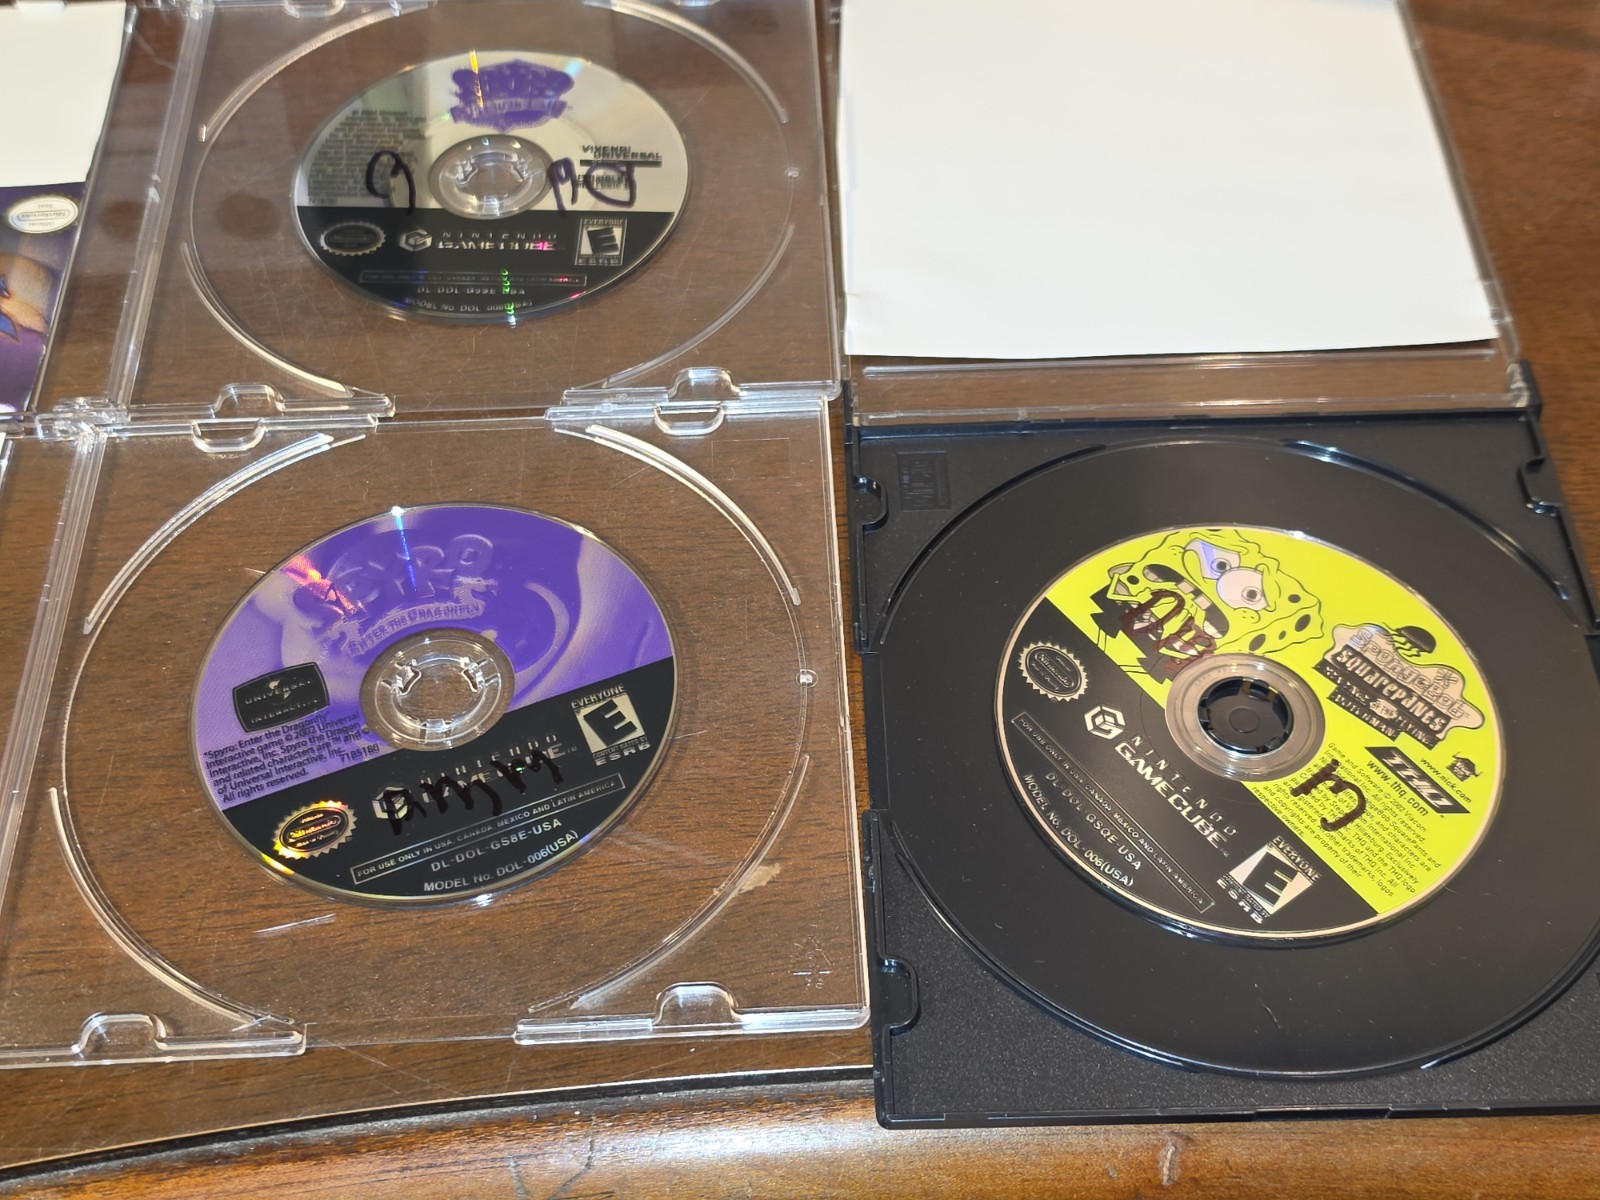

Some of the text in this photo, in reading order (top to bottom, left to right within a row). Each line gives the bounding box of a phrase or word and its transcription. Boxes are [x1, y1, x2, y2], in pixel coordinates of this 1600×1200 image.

[251, 700, 319, 723] INTERACT
[571, 683, 626, 709] EVERYONE
[206, 750, 256, 770] Interactive
[256, 740, 285, 757] game
[317, 711, 361, 732] Universal
[238, 735, 264, 749] Enter
[264, 729, 281, 741] the
[280, 739, 308, 757] Spyro
[308, 733, 326, 747] the
[326, 722, 361, 741] Dragon
[583, 699, 638, 748] E
[213, 774, 233, 787] and
[233, 764, 267, 782] related
[267, 751, 316, 771] characters
[316, 742, 332, 753] are
[343, 730, 361, 744] and
[594, 741, 652, 767] ESRB
[217, 784, 230, 796] of
[230, 771, 274, 792] Universal
[222, 793, 236, 804] All
[236, 784, 265, 801] rights
[1022, 773, 1050, 812] MODEL
[1114, 742, 1228, 849] GAMECUBE
[1251, 786, 1282, 814] respective
[1324, 749, 1359, 782] Intational
[1371, 793, 1382, 802] All
[1380, 801, 1398, 818] rights
[1327, 742, 1345, 758] Game
[1344, 758, 1358, 769] and
[1356, 768, 1383, 793] Software
[1389, 798, 1405, 812] 2002
[1404, 810, 1426, 832] Viacom
[1366, 760, 1430, 817] www.thq.com
[1420, 757, 1472, 804] www.nick.com
[357, 865, 378, 878] FOR
[378, 857, 397, 870] USE
[397, 849, 421, 863] ONLY
[422, 845, 434, 855] IN
[497, 811, 531, 829] MEXICO
[531, 803, 551, 816] AND
[551, 793, 577, 809] LATIN
[577, 780, 616, 799] AMERICA
[1019, 718, 1032, 731] FOR
[1045, 745, 1062, 759] ONLY
[1113, 812, 1138, 837] MEXICO
[1138, 838, 1153, 852] AND
[1153, 852, 1172, 872] LATIN
[1173, 873, 1202, 903] AMERICA
[1262, 785, 1276, 796] and
[1274, 796, 1305, 824] copyrights
[1304, 824, 1315, 834] are
[1313, 834, 1340, 857] property
[1345, 863, 1362, 877] their
[423, 829, 579, 892] MODEL No. DOL-006(USA)
[430, 818, 563, 872] DL-DOL-GS8E-USA
[1272, 835, 1321, 882] EVERYONE
[1273, 783, 1292, 799] rights
[1325, 830, 1342, 847] other
[1376, 878, 1393, 896] logos
[1318, 801, 1327, 810] by
[1352, 832, 1366, 846] THQ
[1364, 846, 1379, 857] and
[1377, 856, 1388, 867] the
[1388, 865, 1402, 880] THQ
[1400, 878, 1415, 893] logo
[1321, 792, 1331, 801] by
[1385, 852, 1418, 883] Exclusively
[1366, 823, 1405, 858] International
[1375, 820, 1389, 831] and
[1387, 831, 1420, 861] characters
[1419, 861, 1431, 871] are
[1389, 821, 1427, 856] SquarePants
[1426, 856, 1441, 868] and
[1241, 851, 1300, 908] E
[1362, 853, 1377, 868] THQ
[1386, 878, 1398, 887] All
